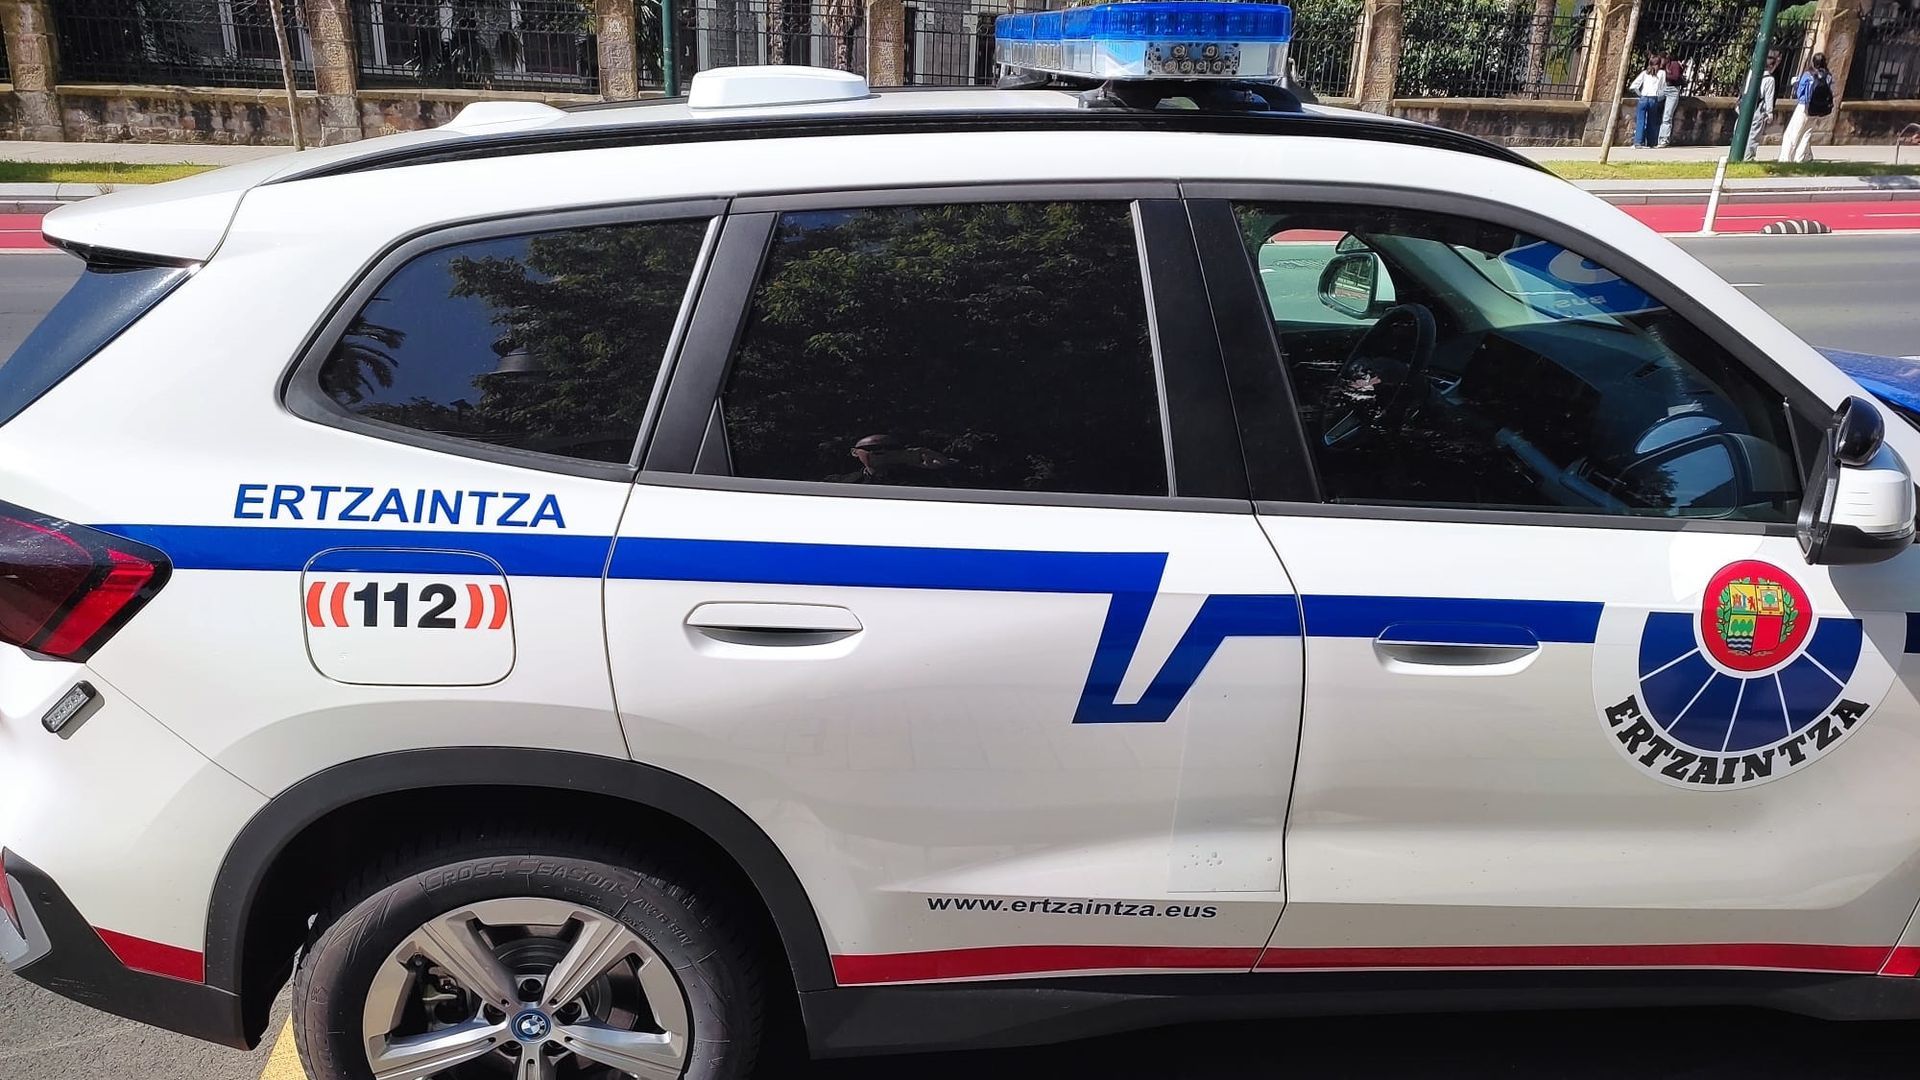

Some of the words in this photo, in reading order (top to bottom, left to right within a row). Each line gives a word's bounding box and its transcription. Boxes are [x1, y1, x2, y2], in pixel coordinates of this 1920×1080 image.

[234, 484, 566, 529] ERTZAINTZA
[1604, 694, 1869, 785] ERTZAINTZA
[927, 897, 1217, 919] www.ertzaintza.eus
